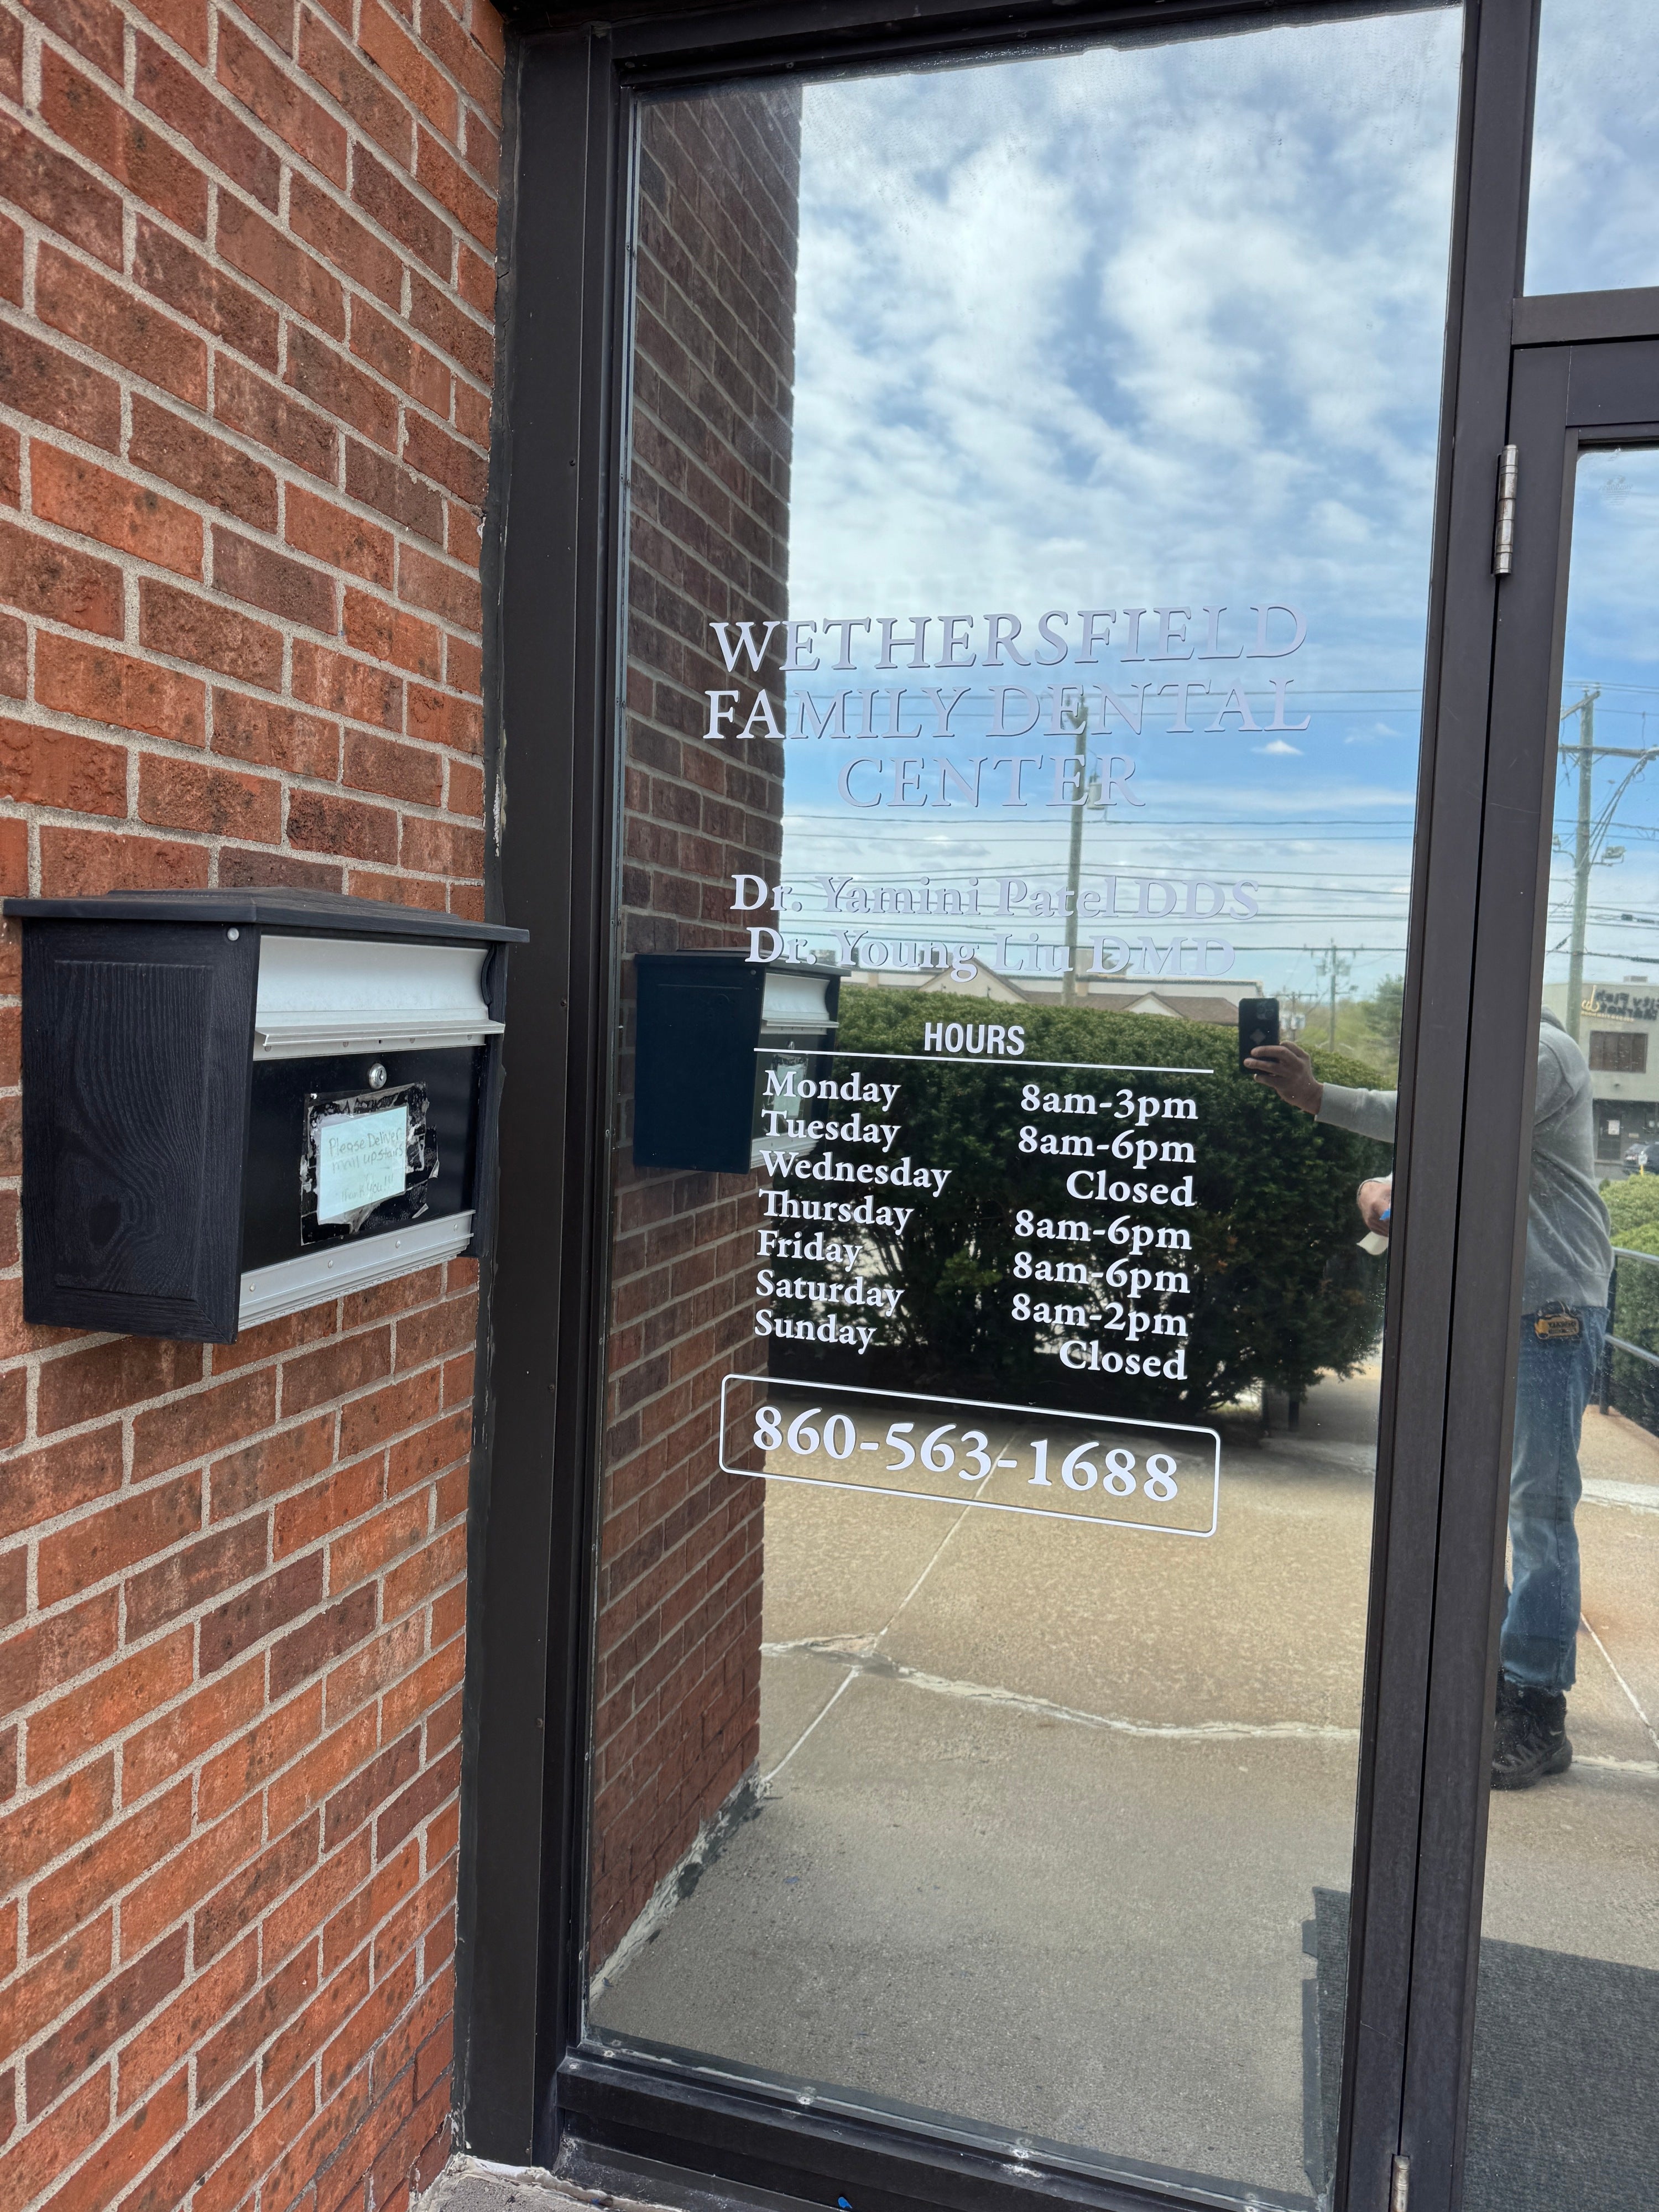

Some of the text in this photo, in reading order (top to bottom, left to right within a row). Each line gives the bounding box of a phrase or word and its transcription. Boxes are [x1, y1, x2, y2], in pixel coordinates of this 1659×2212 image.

[709, 603, 1308, 672] WETHERSFIELD
[703, 679, 1311, 740] FAMILY DENTAL
[838, 755, 1146, 807] CENTER
[729, 874, 1260, 920] Dr. Yamini Patel DDS
[745, 927, 1235, 983] Dr. Young Liu DMD
[925, 1022, 1025, 1056] HOURS
[762, 1070, 1199, 1126] Monday 8am-3pm
[328, 1127, 402, 1157] Please Deliver
[363, 1144, 404, 1165] upstairs
[761, 1109, 1196, 1169] Tuesday 8am-6pm
[760, 1150, 1194, 1207] Wednesday Closed
[758, 1189, 1192, 1255] Thursday 8am-6pm
[757, 1229, 1190, 1298] Friday 8am-6pm
[756, 1270, 1188, 1342] Saturday 8am-2pm
[754, 1309, 1188, 1381] Sunday Closed
[753, 1405, 1178, 1501] 860-563-1688
